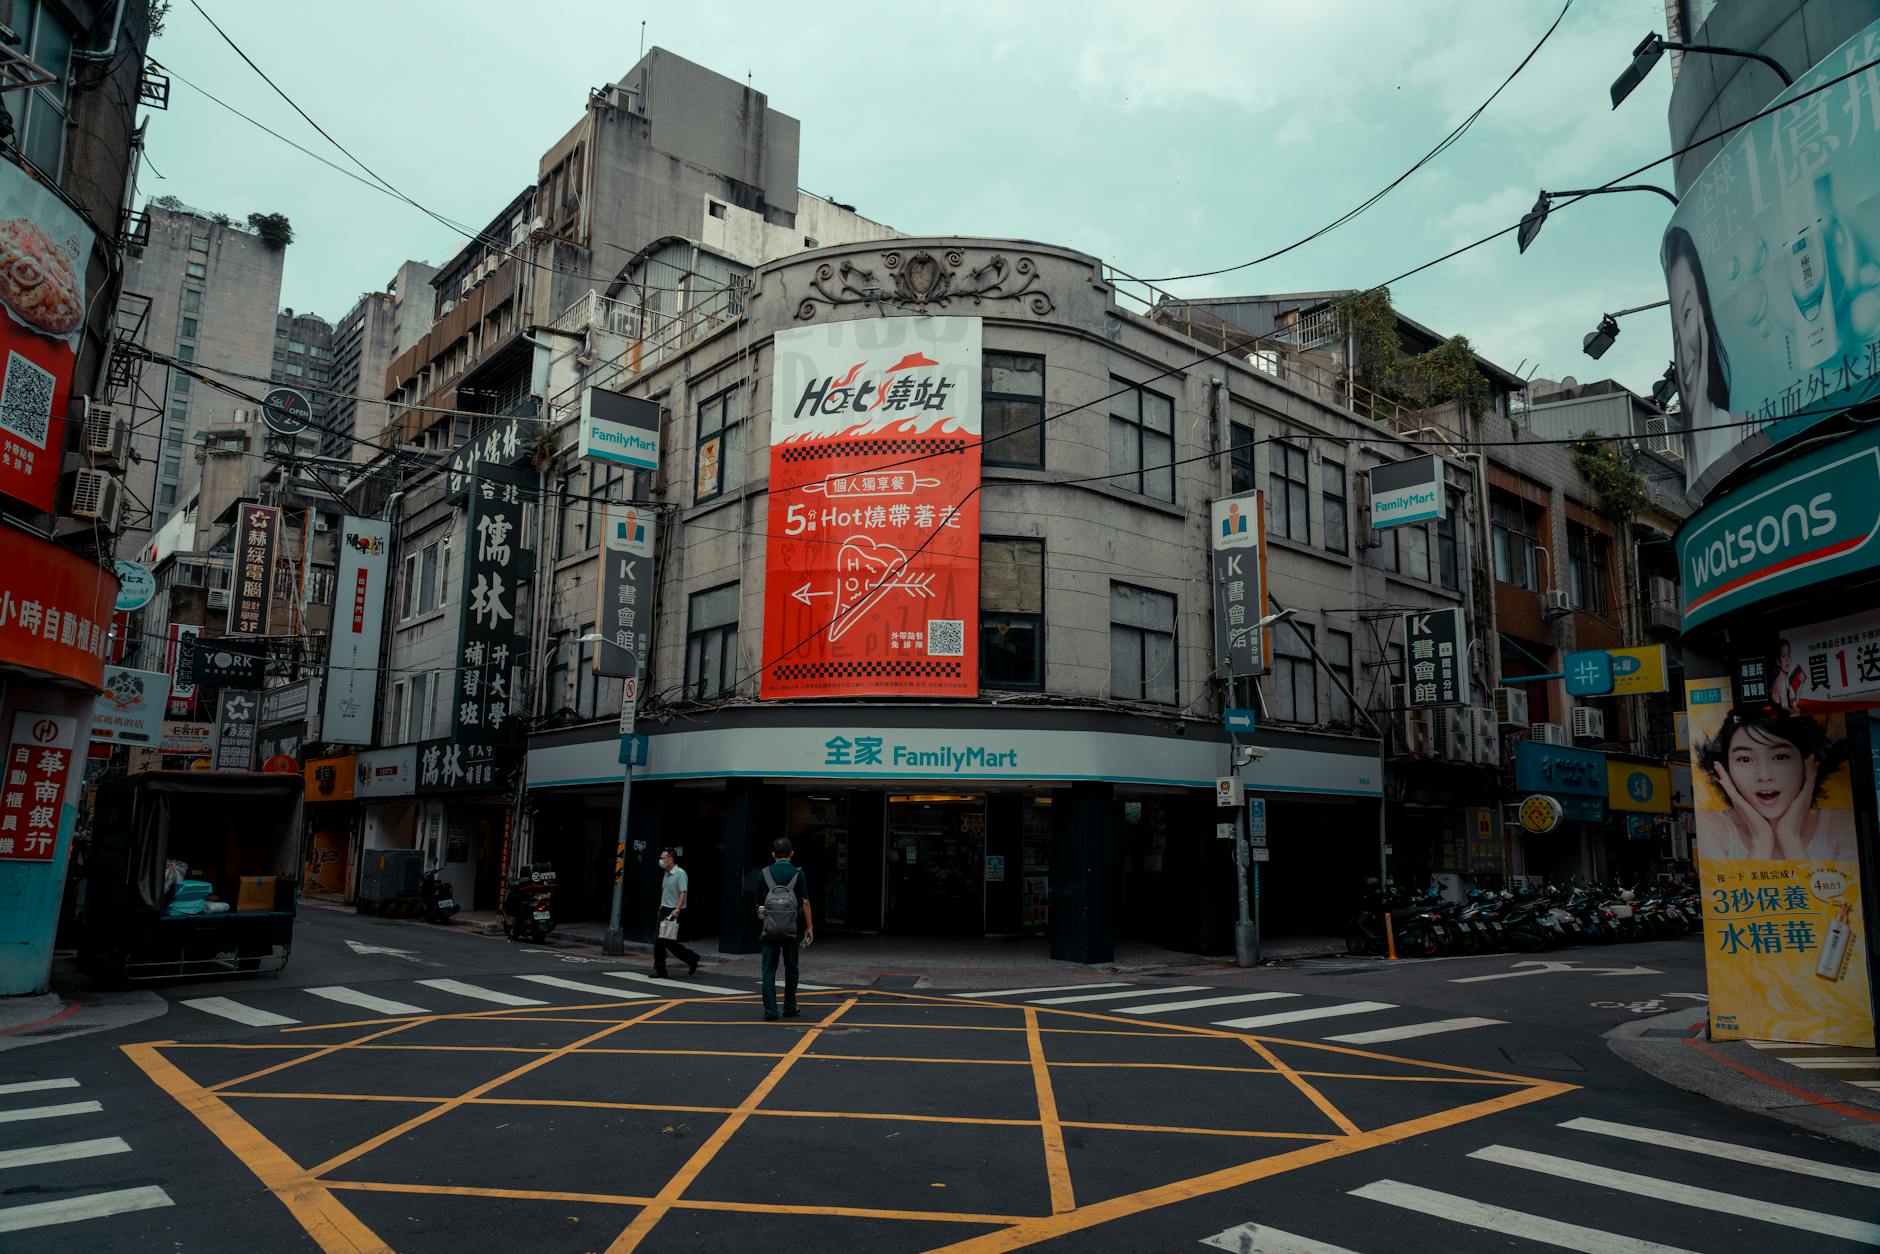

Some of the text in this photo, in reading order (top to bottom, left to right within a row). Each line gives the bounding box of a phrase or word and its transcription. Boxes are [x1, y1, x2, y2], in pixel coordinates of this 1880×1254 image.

[592, 426, 657, 452] FamilyMart
[481, 479, 519, 505] 台北
[833, 475, 905, 493] 個人獨享餐
[1375, 491, 1435, 513] FamilyMart
[785, 503, 806, 536] 5
[1692, 491, 1838, 588] watsons
[469, 513, 514, 631] 儒林
[240, 621, 258, 633] 3F
[204, 652, 253, 668] YORK
[1412, 613, 1438, 703] K書會館
[459, 641, 486, 726] 補習班
[491, 643, 510, 731] 升大學
[421, 744, 464, 787] 儒林
[824, 735, 1018, 772] 全家 FamilyMart
[24, 750, 65, 855] 華南銀行
[1712, 885, 1811, 914] 3秒保養
[1717, 920, 1819, 954] 水精華
